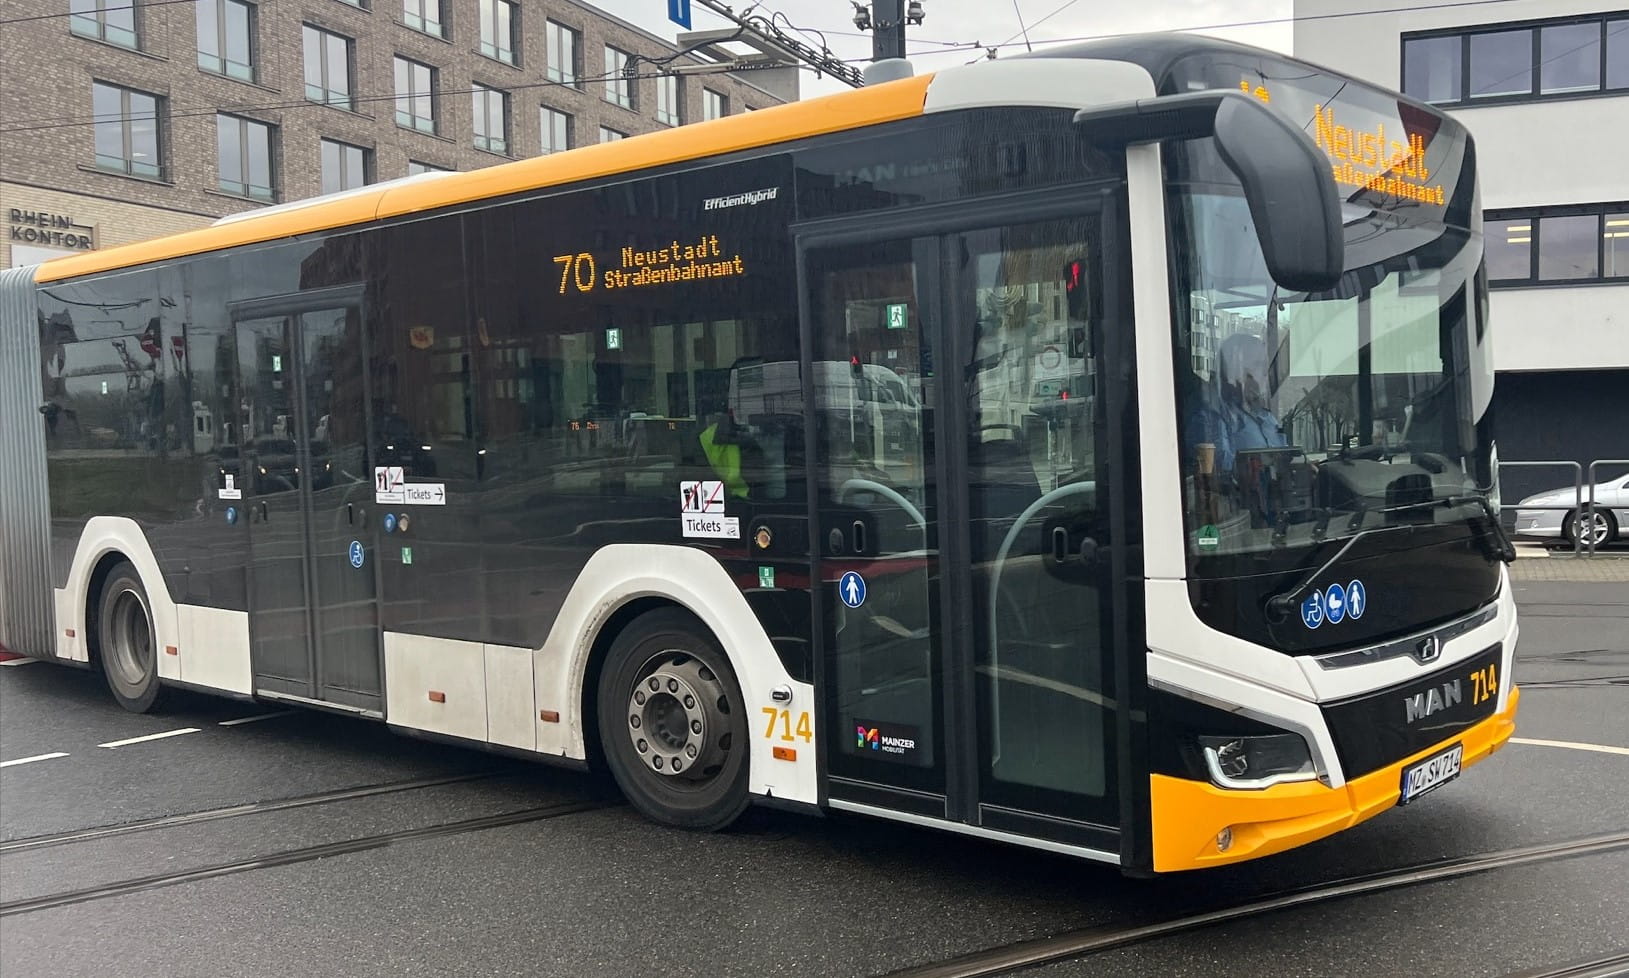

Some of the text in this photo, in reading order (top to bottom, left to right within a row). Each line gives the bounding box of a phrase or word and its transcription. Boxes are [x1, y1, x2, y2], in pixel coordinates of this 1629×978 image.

[1313, 103, 1429, 181] Neustadt
[704, 188, 778, 211] EfficientHybrid
[1332, 162, 1444, 206] aßenbahnamt
[10, 208, 70, 229] RHEIN
[11, 226, 90, 249] KONTOR
[621, 235, 720, 268] Neustadt
[553, 252, 596, 294] 70
[604, 255, 745, 289] Straßenbahnamt
[407, 488, 431, 500] Tickets
[686, 519, 721, 532] Tickets
[1404, 679, 1462, 724] MAN
[1470, 664, 1497, 705] 714
[762, 707, 812, 743] 714
[881, 736, 915, 749] MAINZER
[1408, 767, 1423, 793] MZ
[1443, 749, 1460, 776] 714
